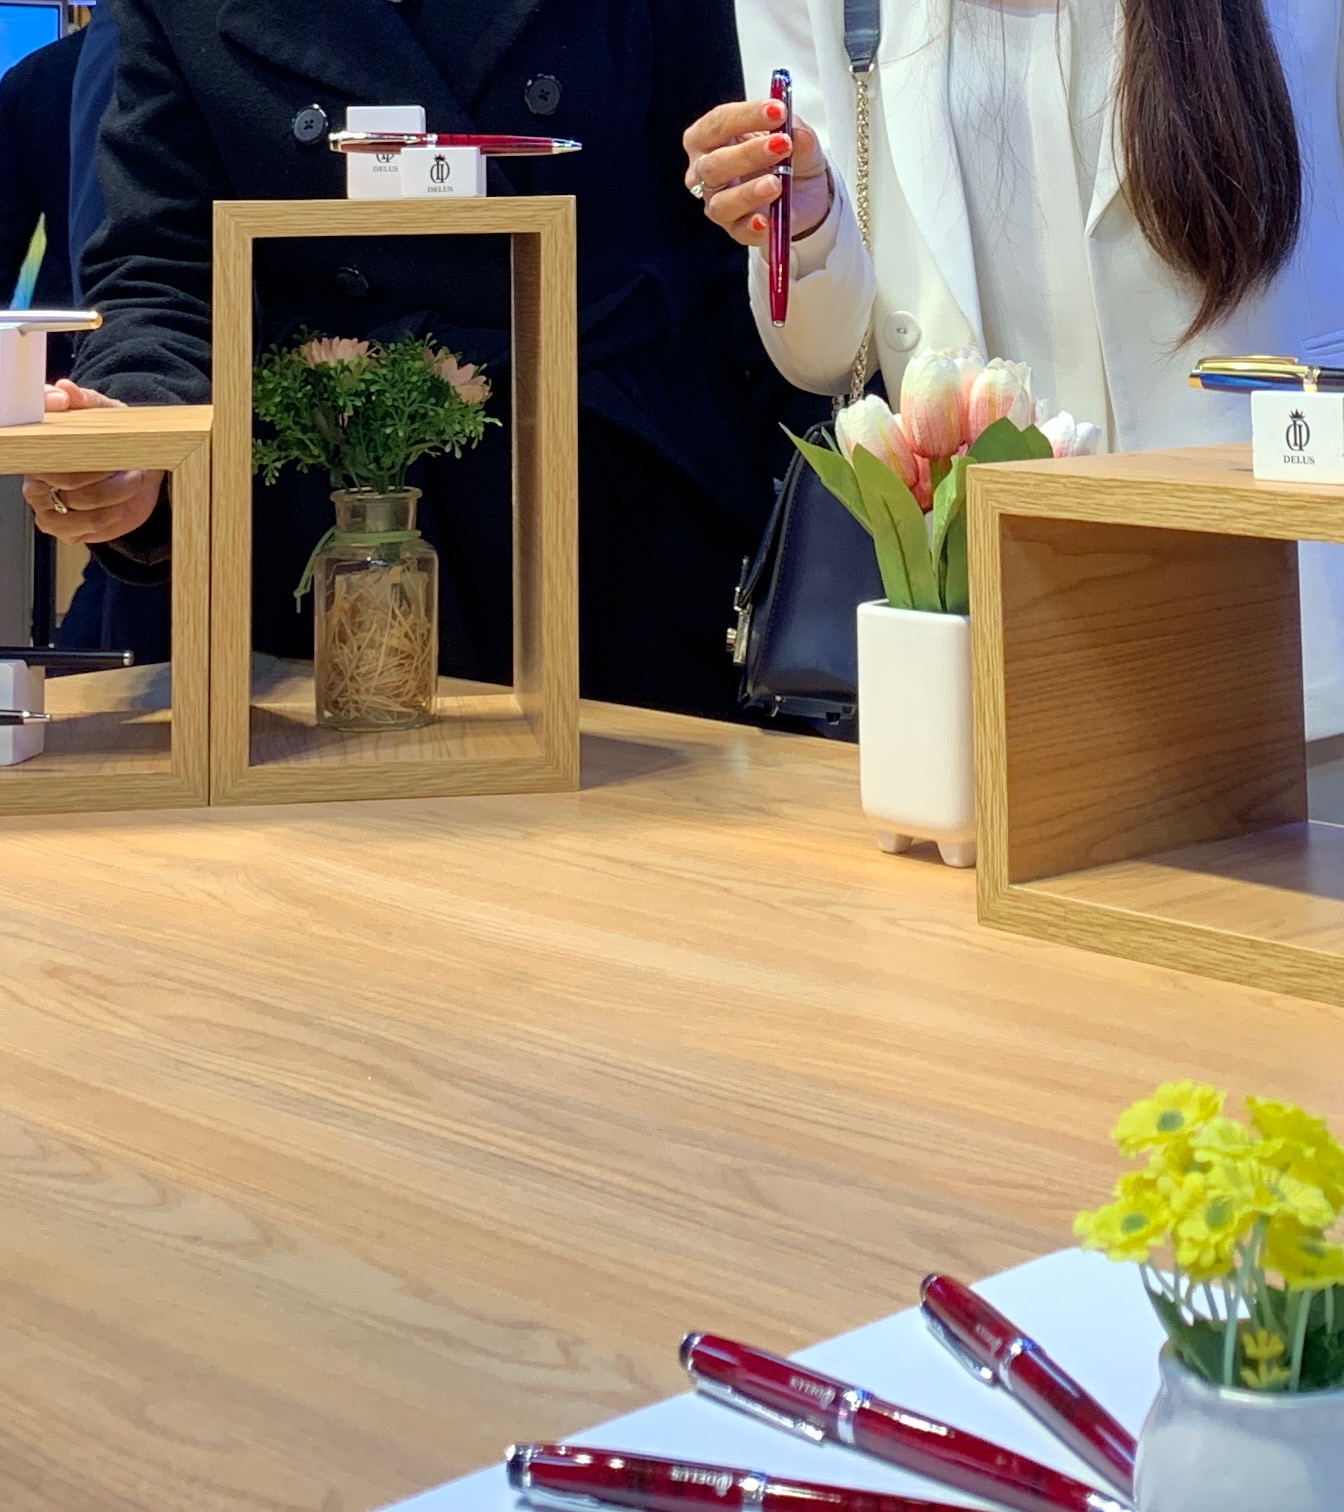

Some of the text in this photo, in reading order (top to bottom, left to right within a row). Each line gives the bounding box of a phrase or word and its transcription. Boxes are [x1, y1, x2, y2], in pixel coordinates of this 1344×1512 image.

[372, 165, 398, 173] DELUS
[1283, 454, 1315, 465] DELUS
[670, 1465, 717, 1487] DELUS
